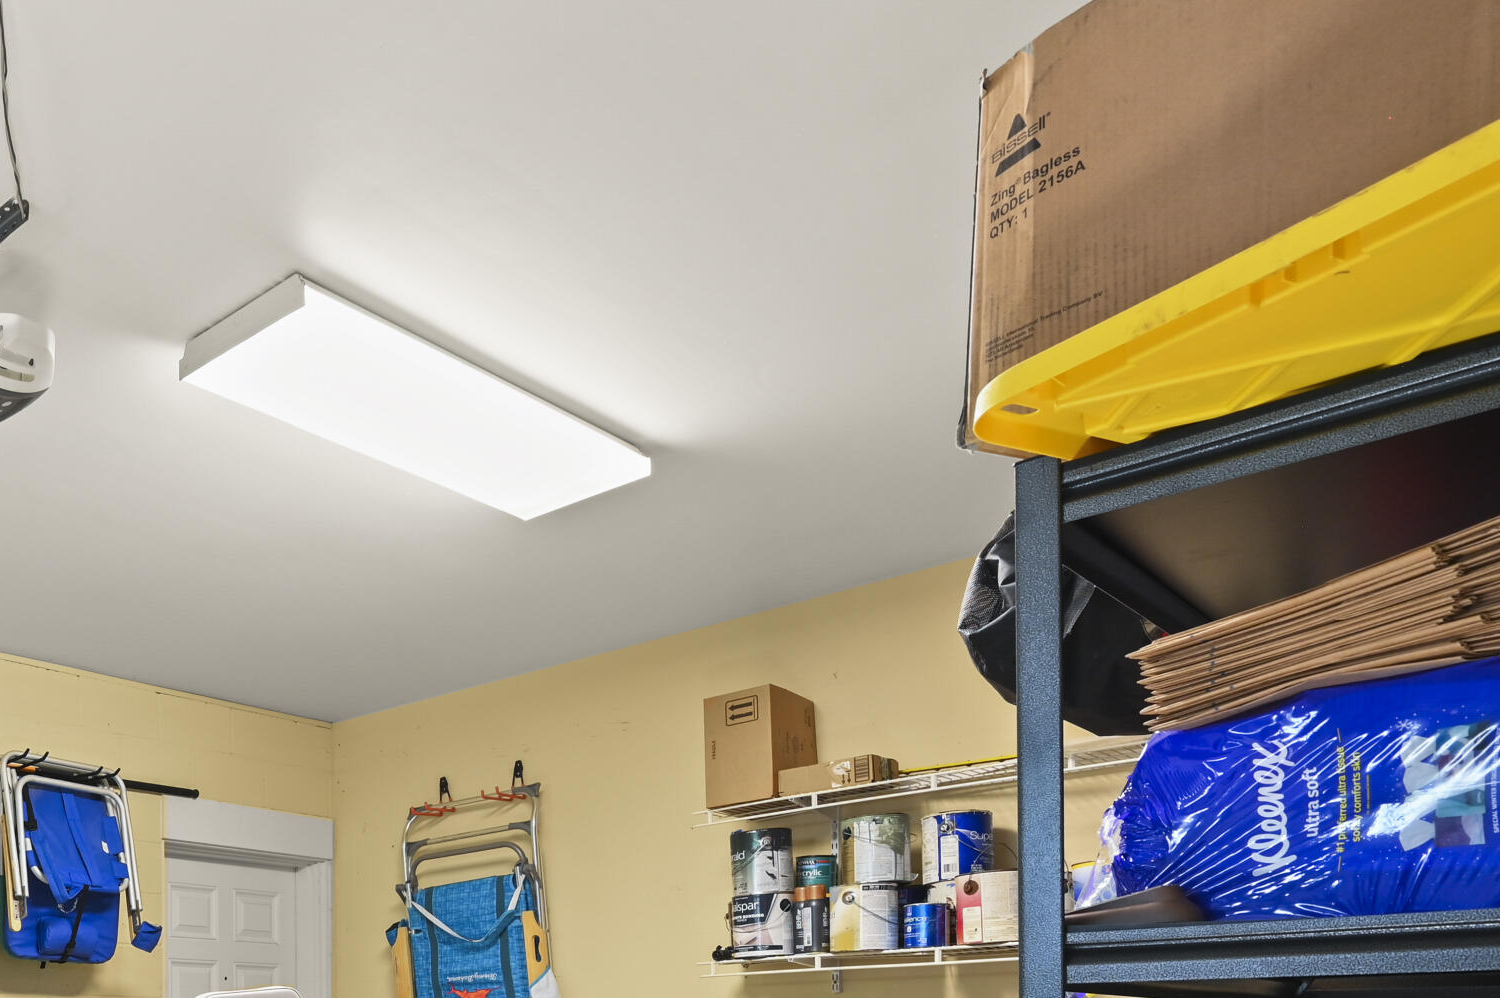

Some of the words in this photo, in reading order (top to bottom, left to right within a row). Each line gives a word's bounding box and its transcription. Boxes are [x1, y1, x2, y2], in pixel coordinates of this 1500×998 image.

[1023, 146, 1081, 185] Bagless
[990, 188, 1034, 223] MODEL
[1038, 160, 1086, 194] 2156A
[989, 215, 1018, 239] QTY:
[1022, 207, 1028, 218] 1
[1301, 766, 1319, 798] soft
[1336, 775, 1347, 797] ultra
[1351, 772, 1362, 813] comforts
[1247, 740, 1298, 877] Kleenex
[1303, 799, 1320, 838] ultra
[1336, 798, 1348, 841] prferred
[1336, 842, 1345, 854] #1
